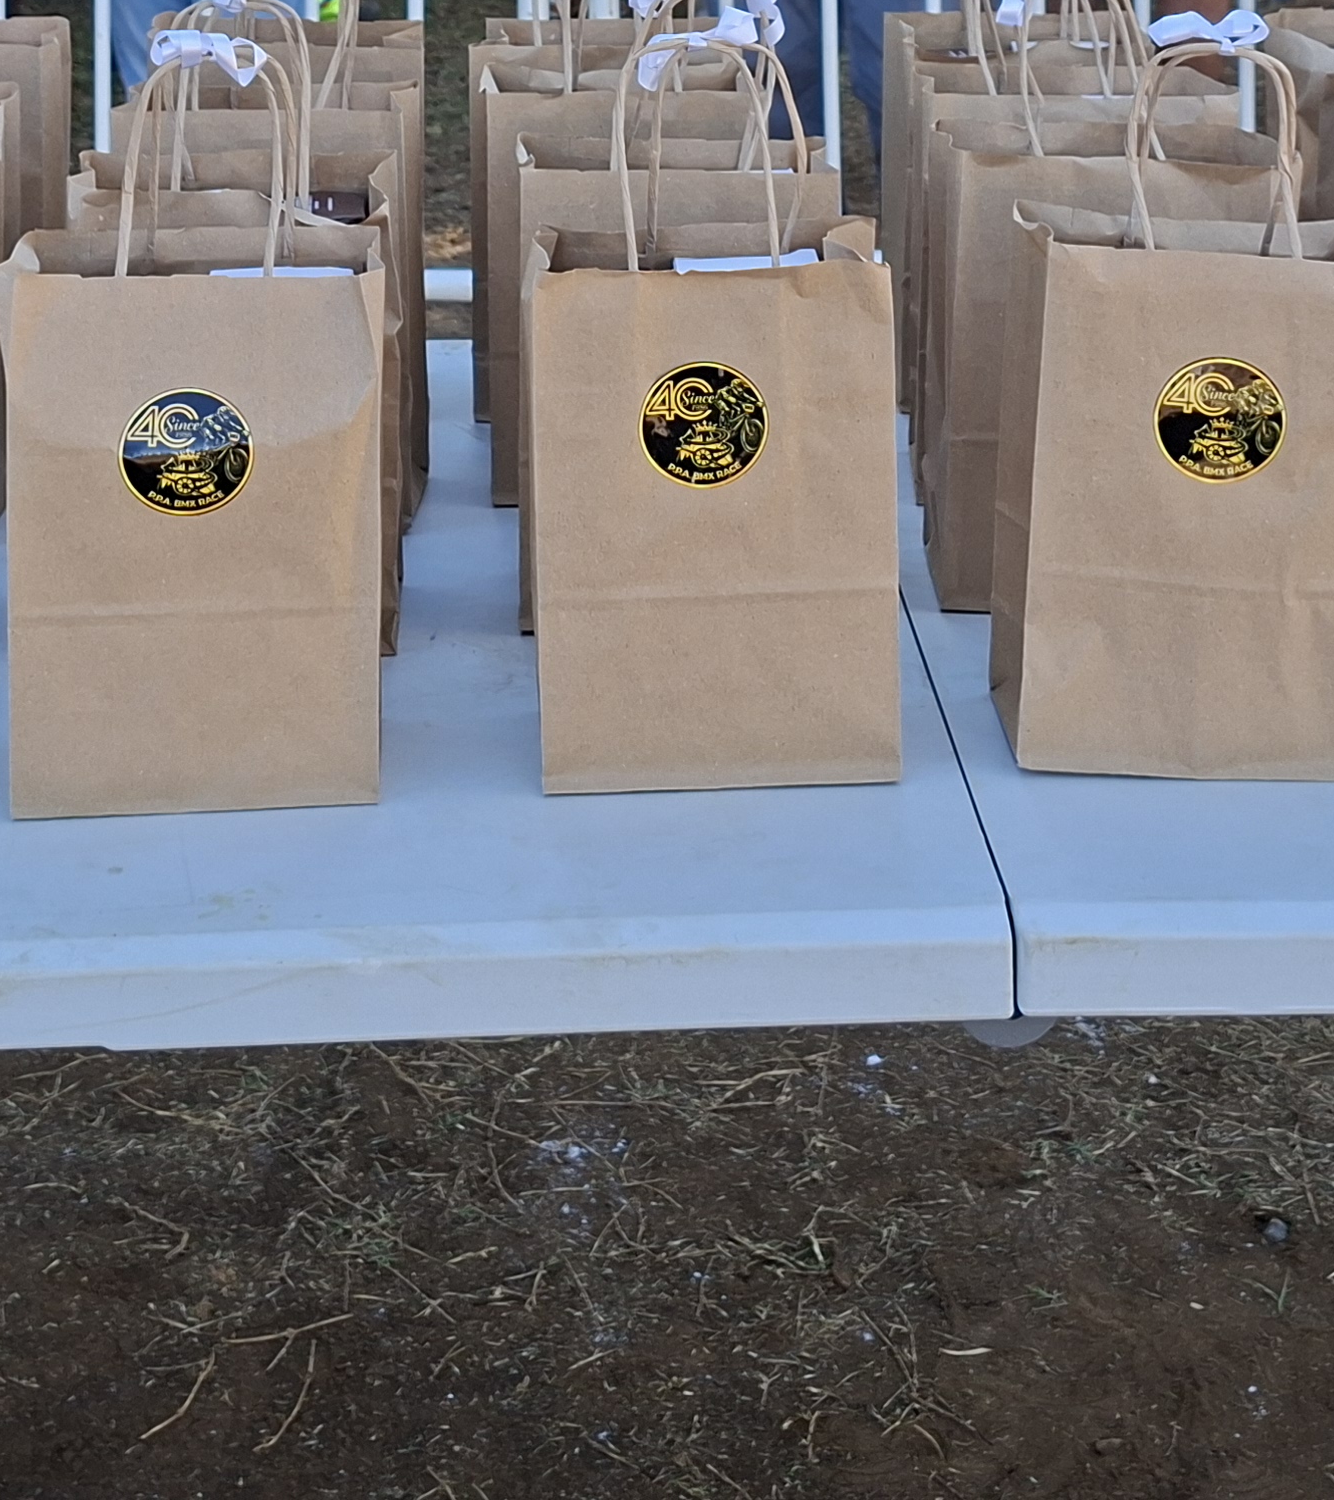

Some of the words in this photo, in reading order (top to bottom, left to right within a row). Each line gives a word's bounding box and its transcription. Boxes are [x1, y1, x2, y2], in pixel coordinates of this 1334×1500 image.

[681, 390, 715, 406] Since
[1201, 384, 1236, 401] Since
[165, 416, 200, 433] Since
[694, 472, 715, 481] BMX
[716, 461, 742, 479] RACE
[1203, 466, 1225, 476] BMX
[1227, 460, 1254, 476] RACE
[174, 499, 196, 508] BMX
[198, 490, 225, 506] RACE
